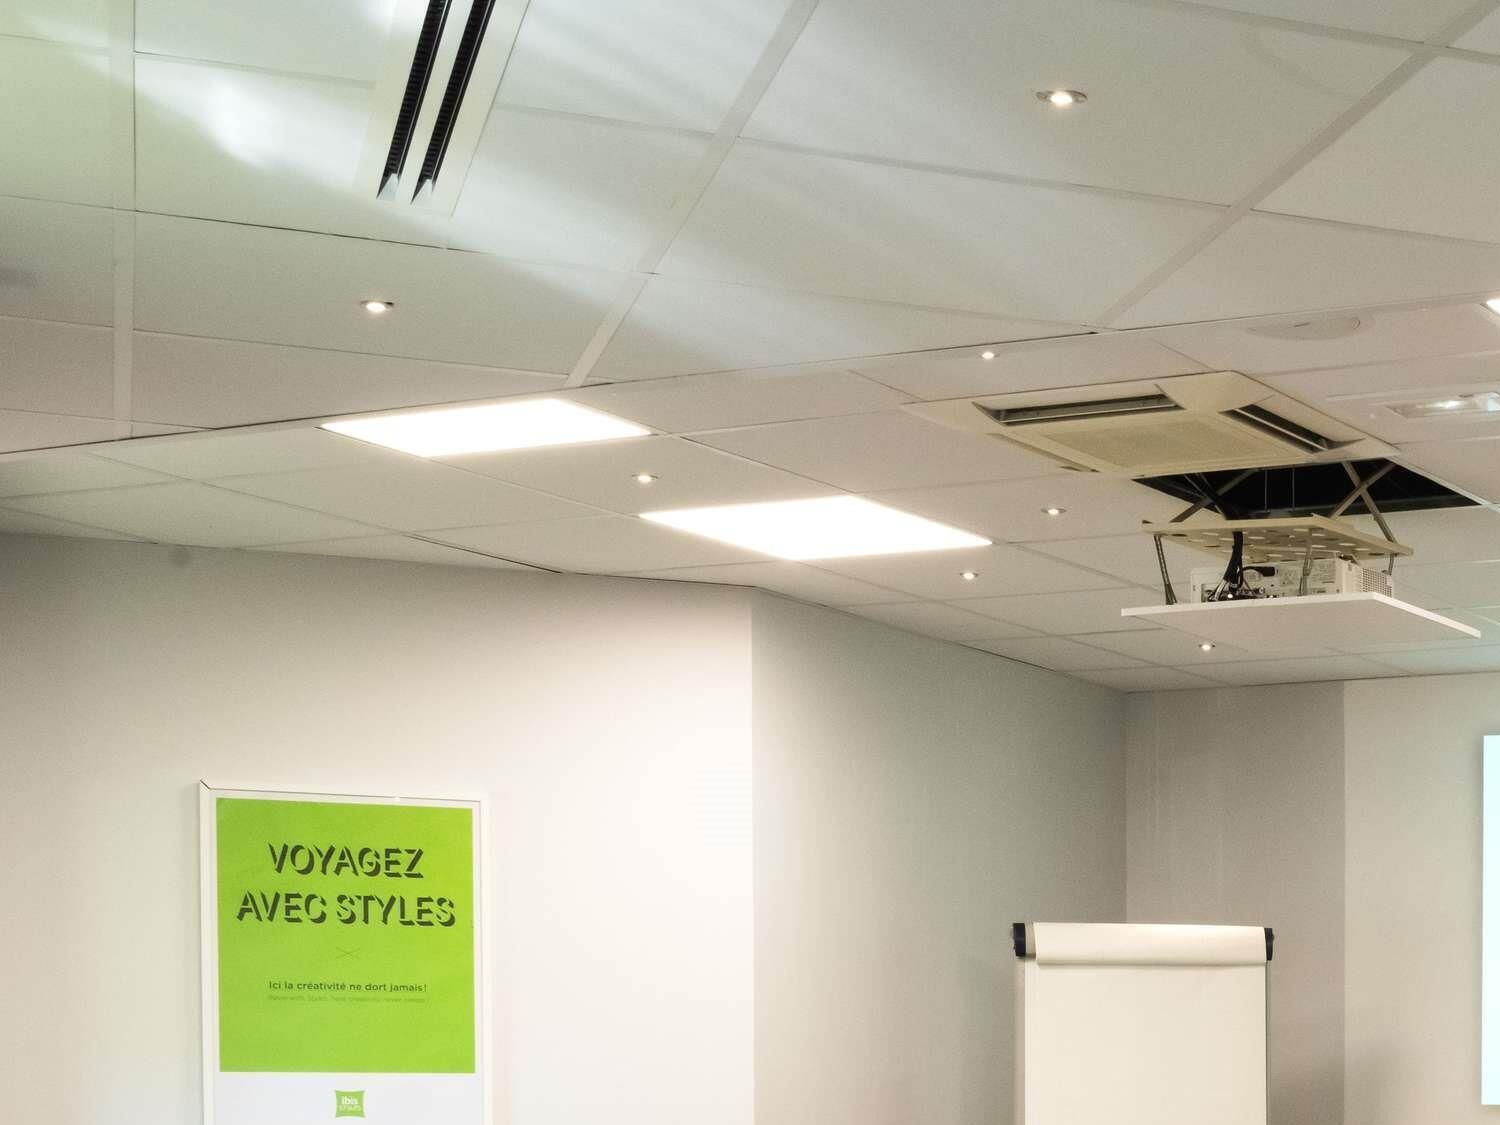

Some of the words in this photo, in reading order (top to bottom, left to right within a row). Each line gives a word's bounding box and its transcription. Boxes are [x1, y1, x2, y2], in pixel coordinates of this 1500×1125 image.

[267, 842, 425, 879] VOYAGEZ
[236, 889, 327, 924] AVEC
[336, 893, 456, 927] STYLES
[284, 981, 294, 990] la
[364, 983, 387, 992] dort
